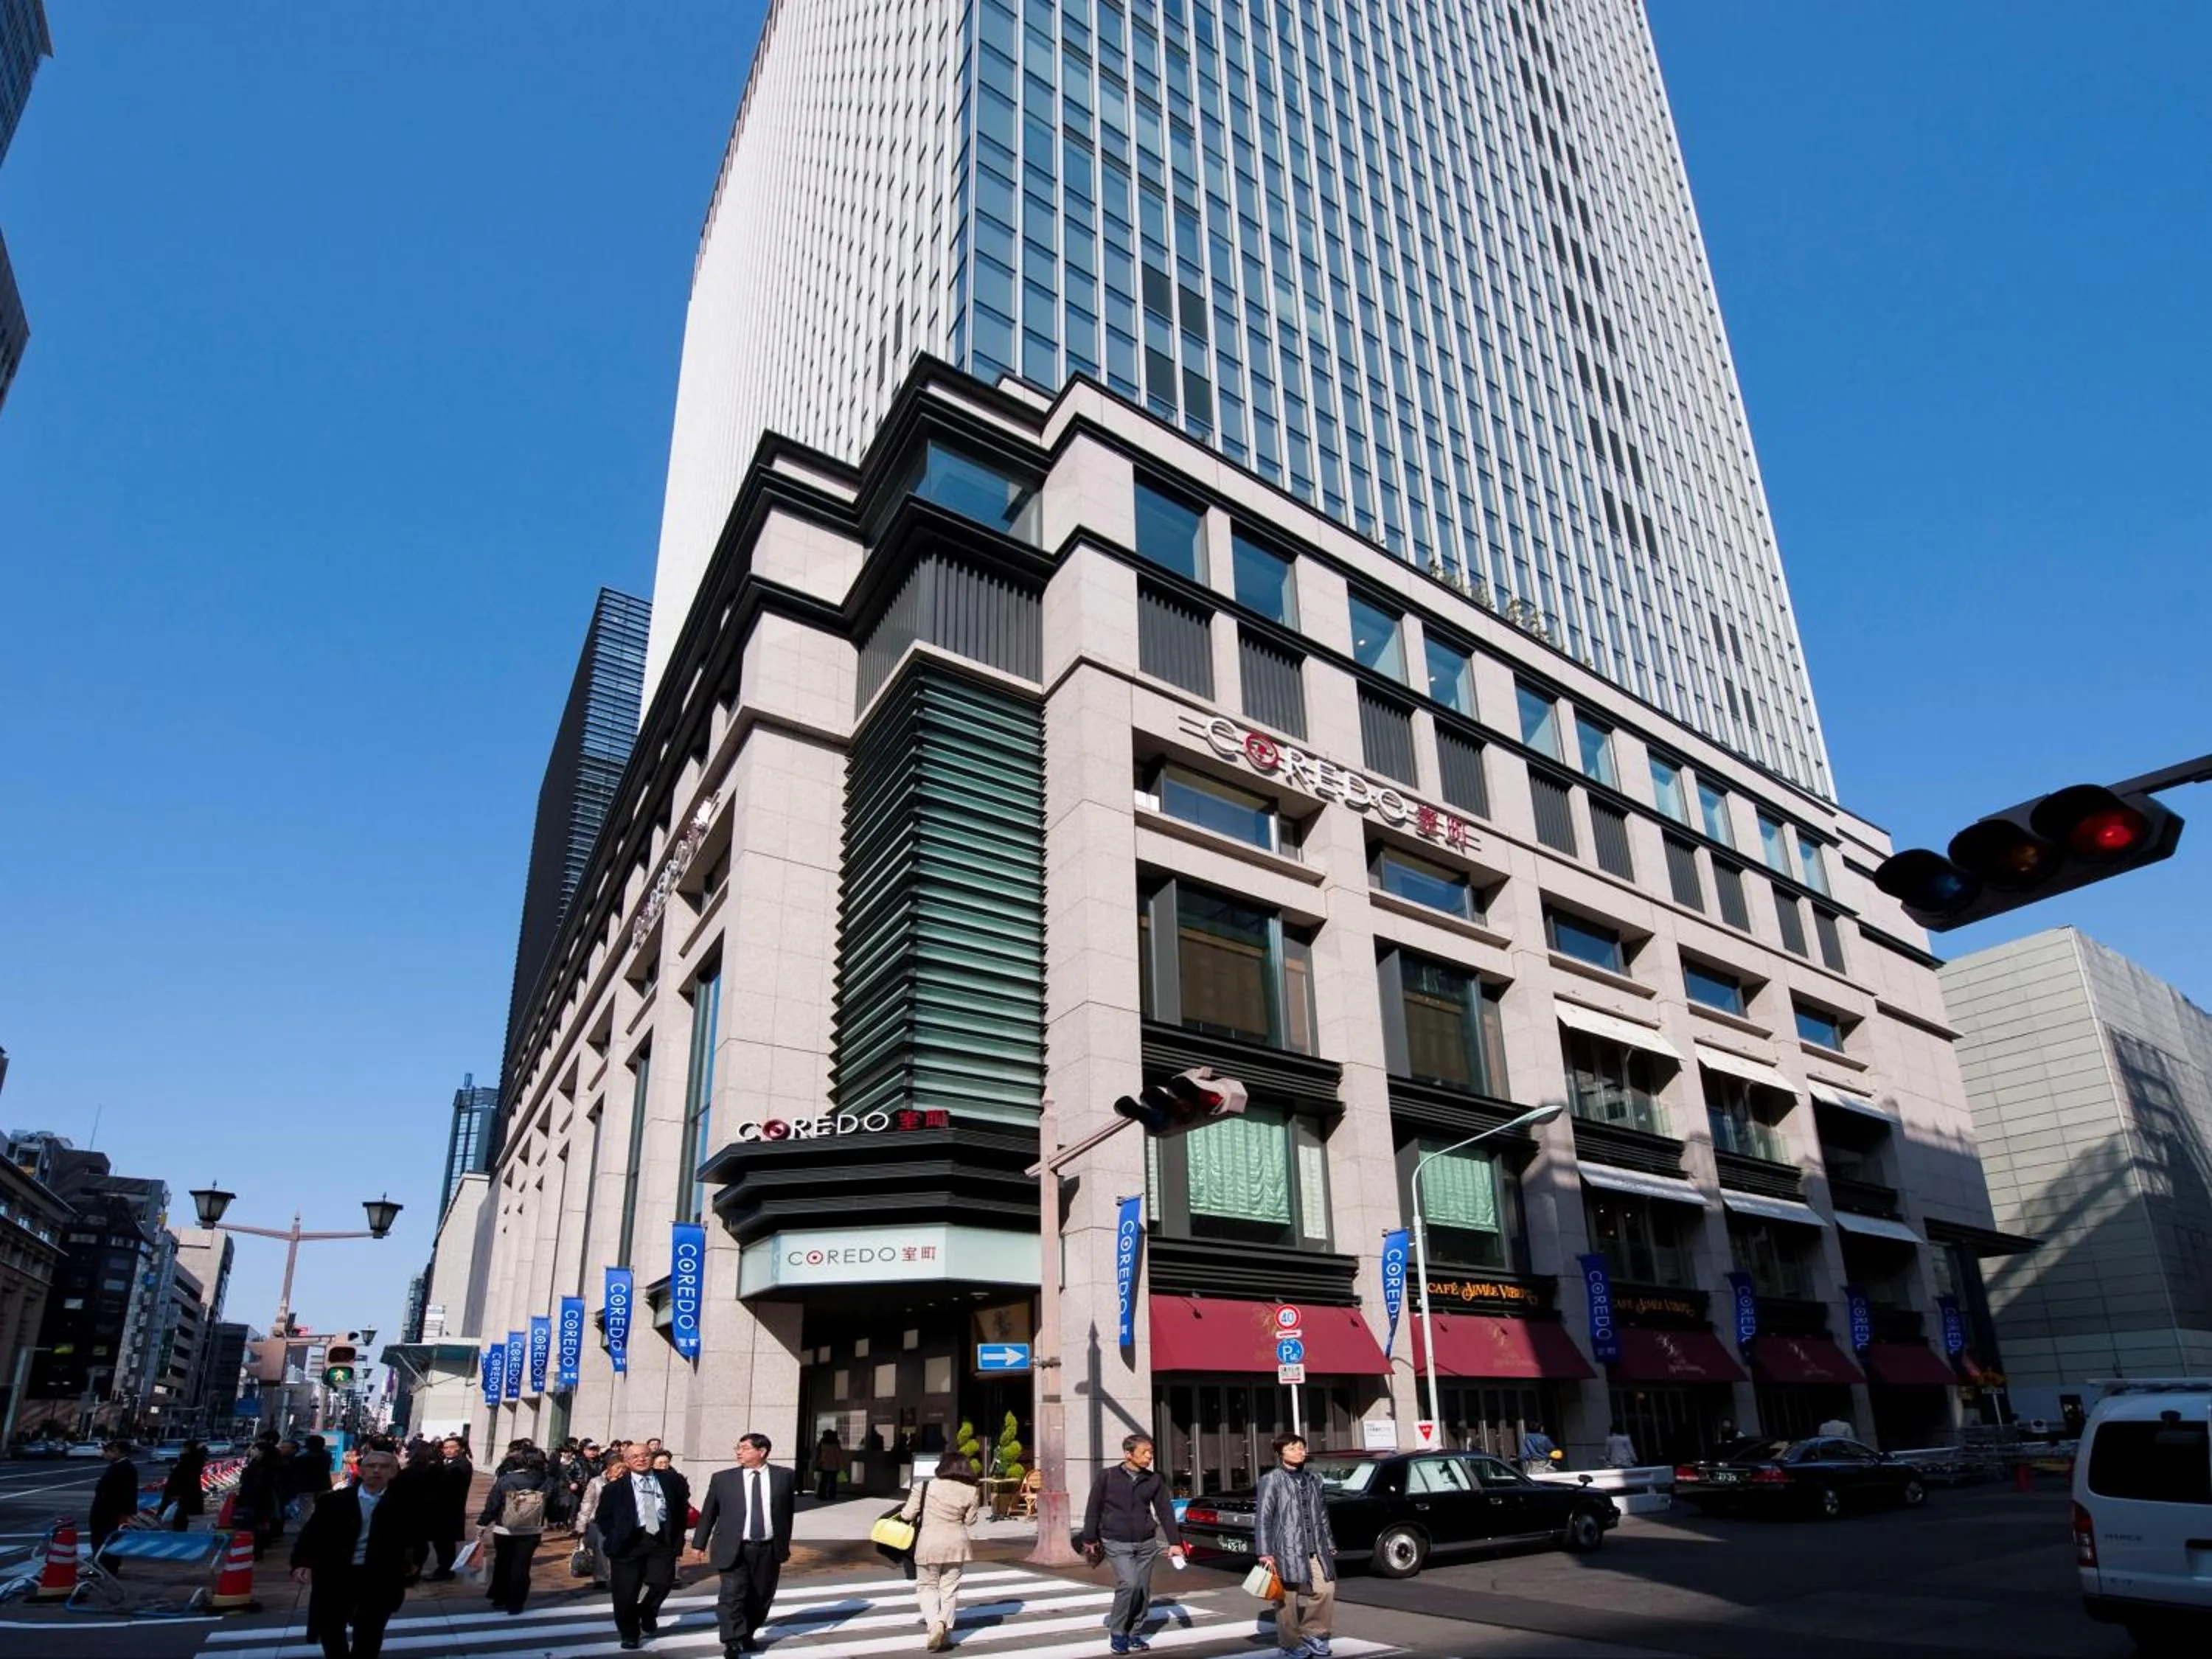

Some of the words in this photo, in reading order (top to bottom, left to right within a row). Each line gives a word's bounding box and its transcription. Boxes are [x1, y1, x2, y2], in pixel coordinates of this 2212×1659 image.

[1206, 717, 1408, 819] COREDO
[737, 1111, 889, 1140] COREDO
[788, 1247, 896, 1266] COREDO
[902, 1245, 937, 1262] 室町
[1119, 1220, 1135, 1315] COREDO
[1385, 1248, 1402, 1318] CORED
[678, 1244, 697, 1329] COREDO
[1589, 1270, 1613, 1340] COREDO
[563, 1310, 579, 1368] COREDO
[610, 1283, 626, 1352] COREDO
[1281, 1312, 1295, 1323] 40
[1852, 1298, 1870, 1352] CORED
[1944, 1307, 1962, 1354] CORED
[533, 1327, 546, 1377] COREDO
[1283, 1346, 1293, 1362] P
